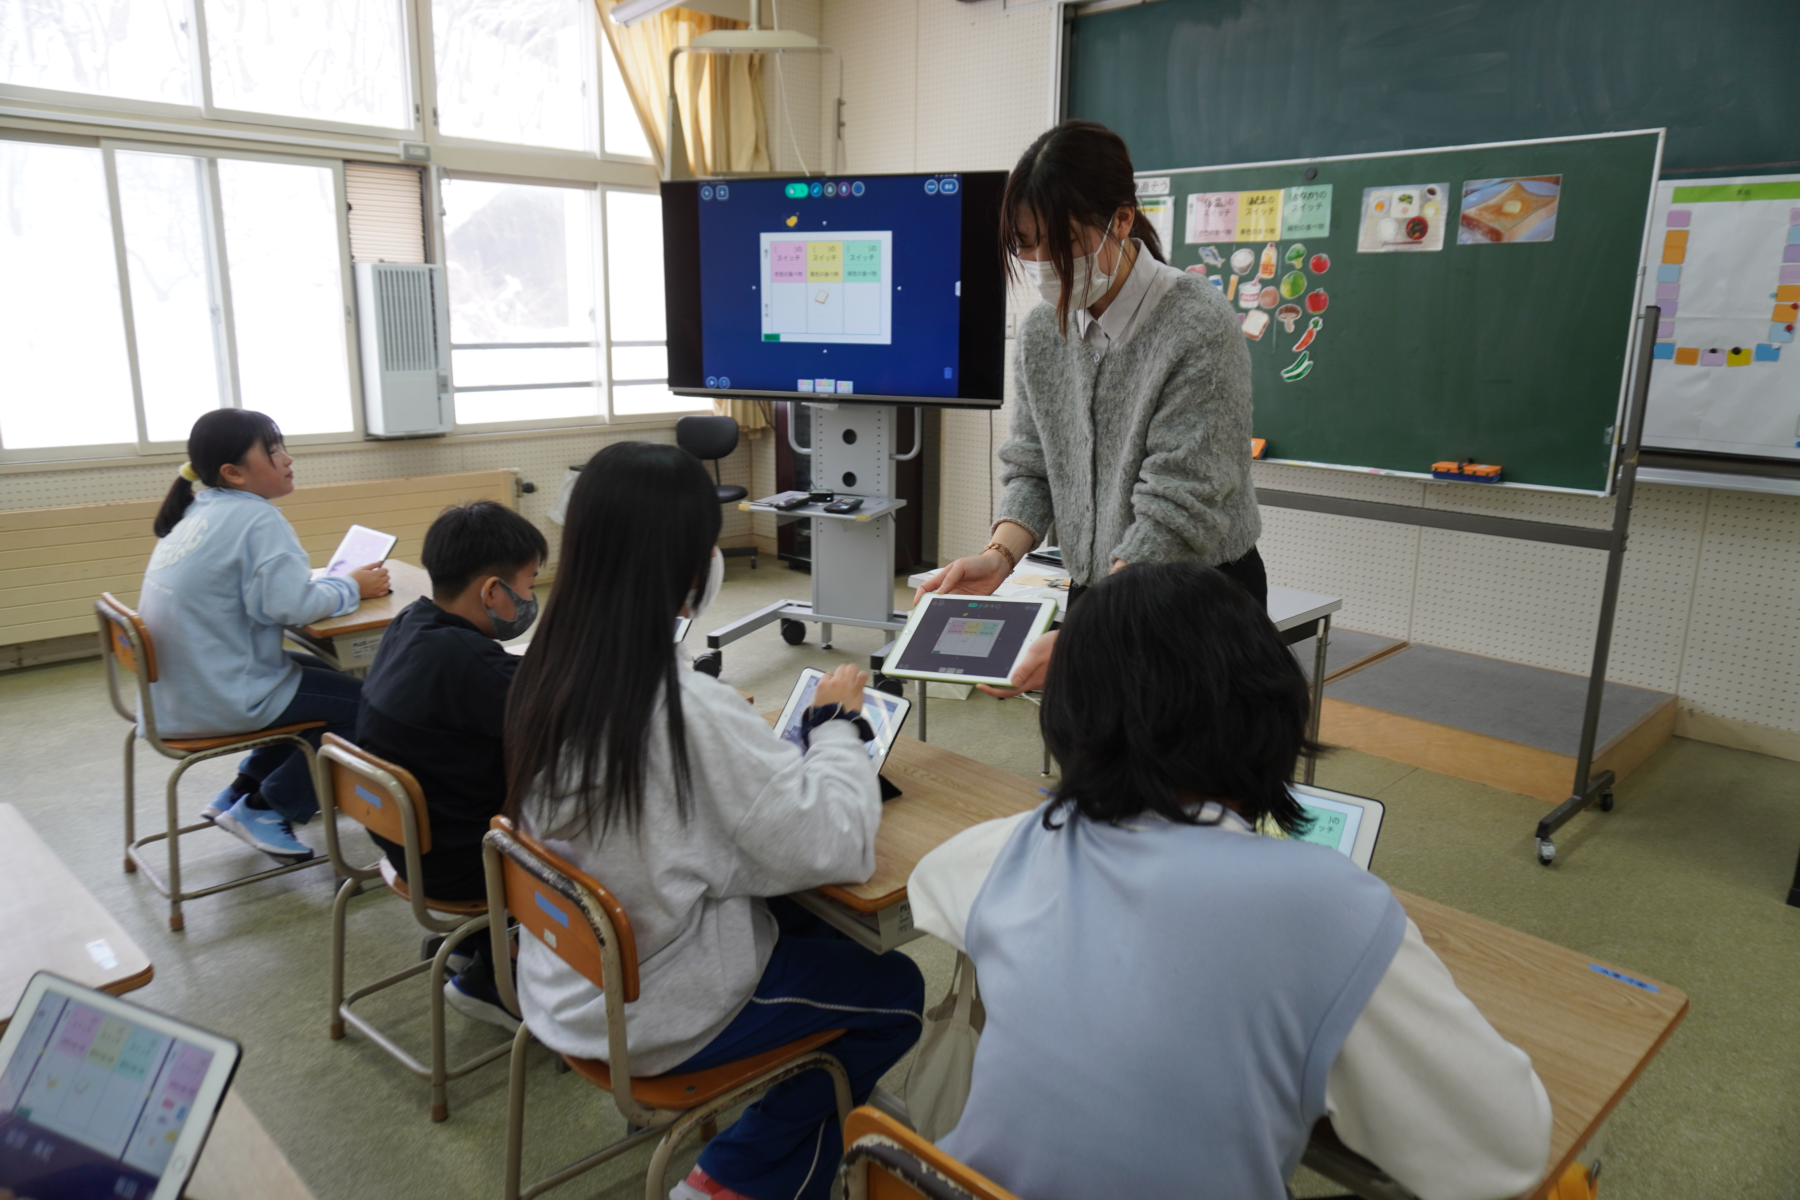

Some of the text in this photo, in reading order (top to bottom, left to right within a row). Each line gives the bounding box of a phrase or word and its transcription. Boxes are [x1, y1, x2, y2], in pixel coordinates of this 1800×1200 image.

[1245, 207, 1275, 216] スイッチ
[1291, 202, 1323, 212] スイッチ
[1204, 208, 1231, 217] スイッチ
